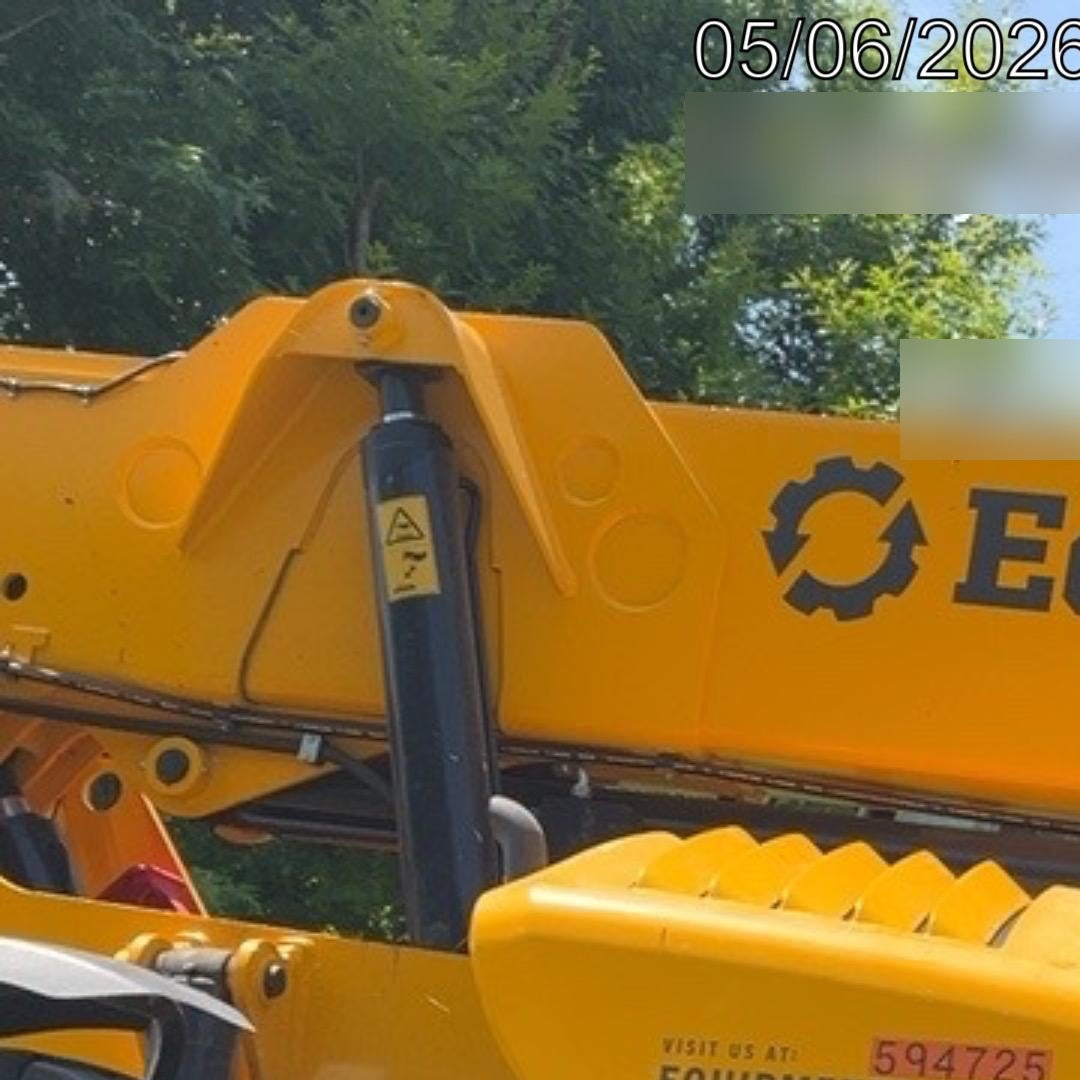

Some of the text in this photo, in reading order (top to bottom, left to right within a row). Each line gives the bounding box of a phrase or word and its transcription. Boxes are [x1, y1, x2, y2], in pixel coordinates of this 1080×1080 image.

[662, 1038, 798, 1062] VISIT US AT:
